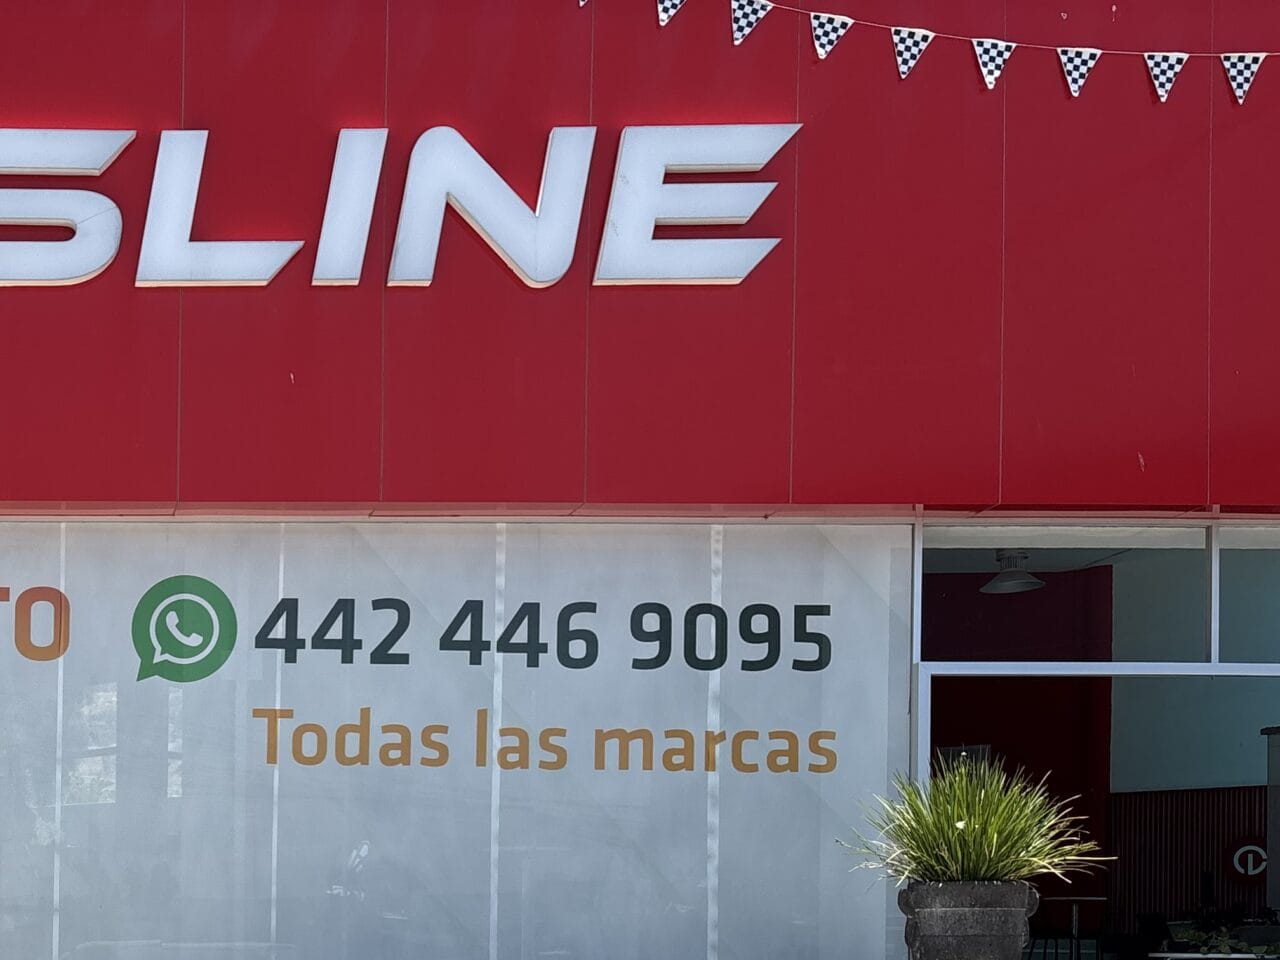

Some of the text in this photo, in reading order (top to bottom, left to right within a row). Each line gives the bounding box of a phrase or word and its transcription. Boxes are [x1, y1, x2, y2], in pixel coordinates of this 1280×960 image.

[254, 597, 832, 672] 442 446 9095
[252, 706, 839, 774] Todas las marcas
